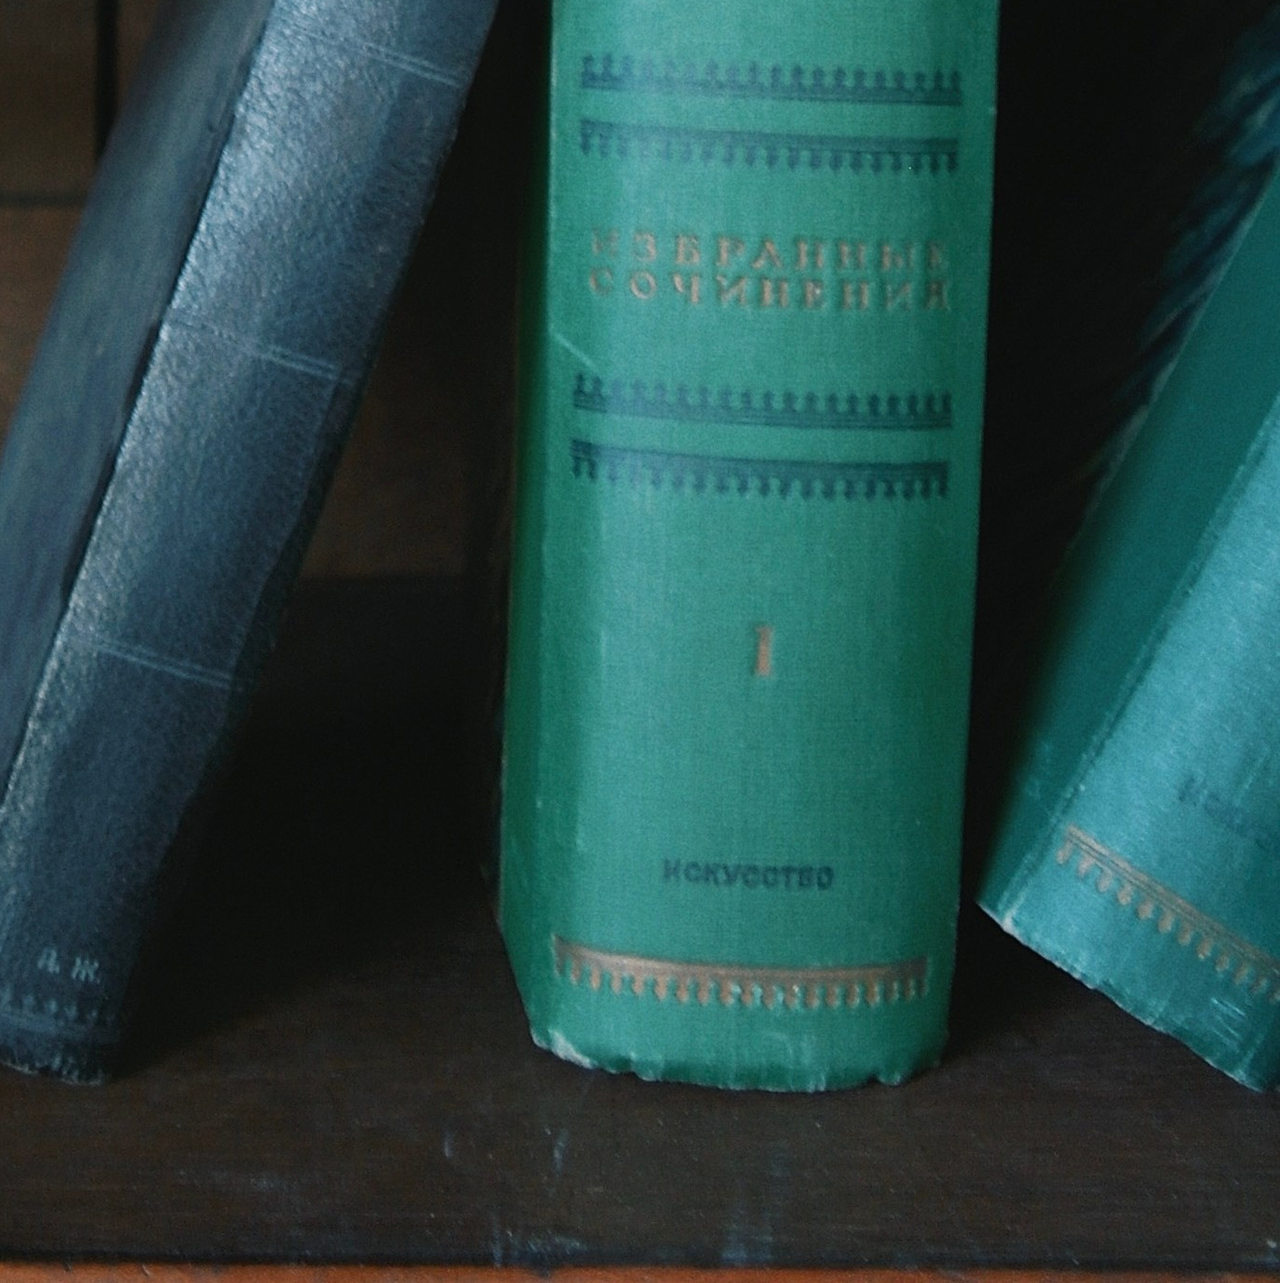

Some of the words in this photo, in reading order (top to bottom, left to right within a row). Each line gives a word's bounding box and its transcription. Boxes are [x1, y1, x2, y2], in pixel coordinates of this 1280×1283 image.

[592, 227, 949, 271] ИЗБРАННЫЕ
[589, 267, 950, 312] СОЧИНЕНИЯ
[662, 859, 836, 891] ИСКУССТВО
